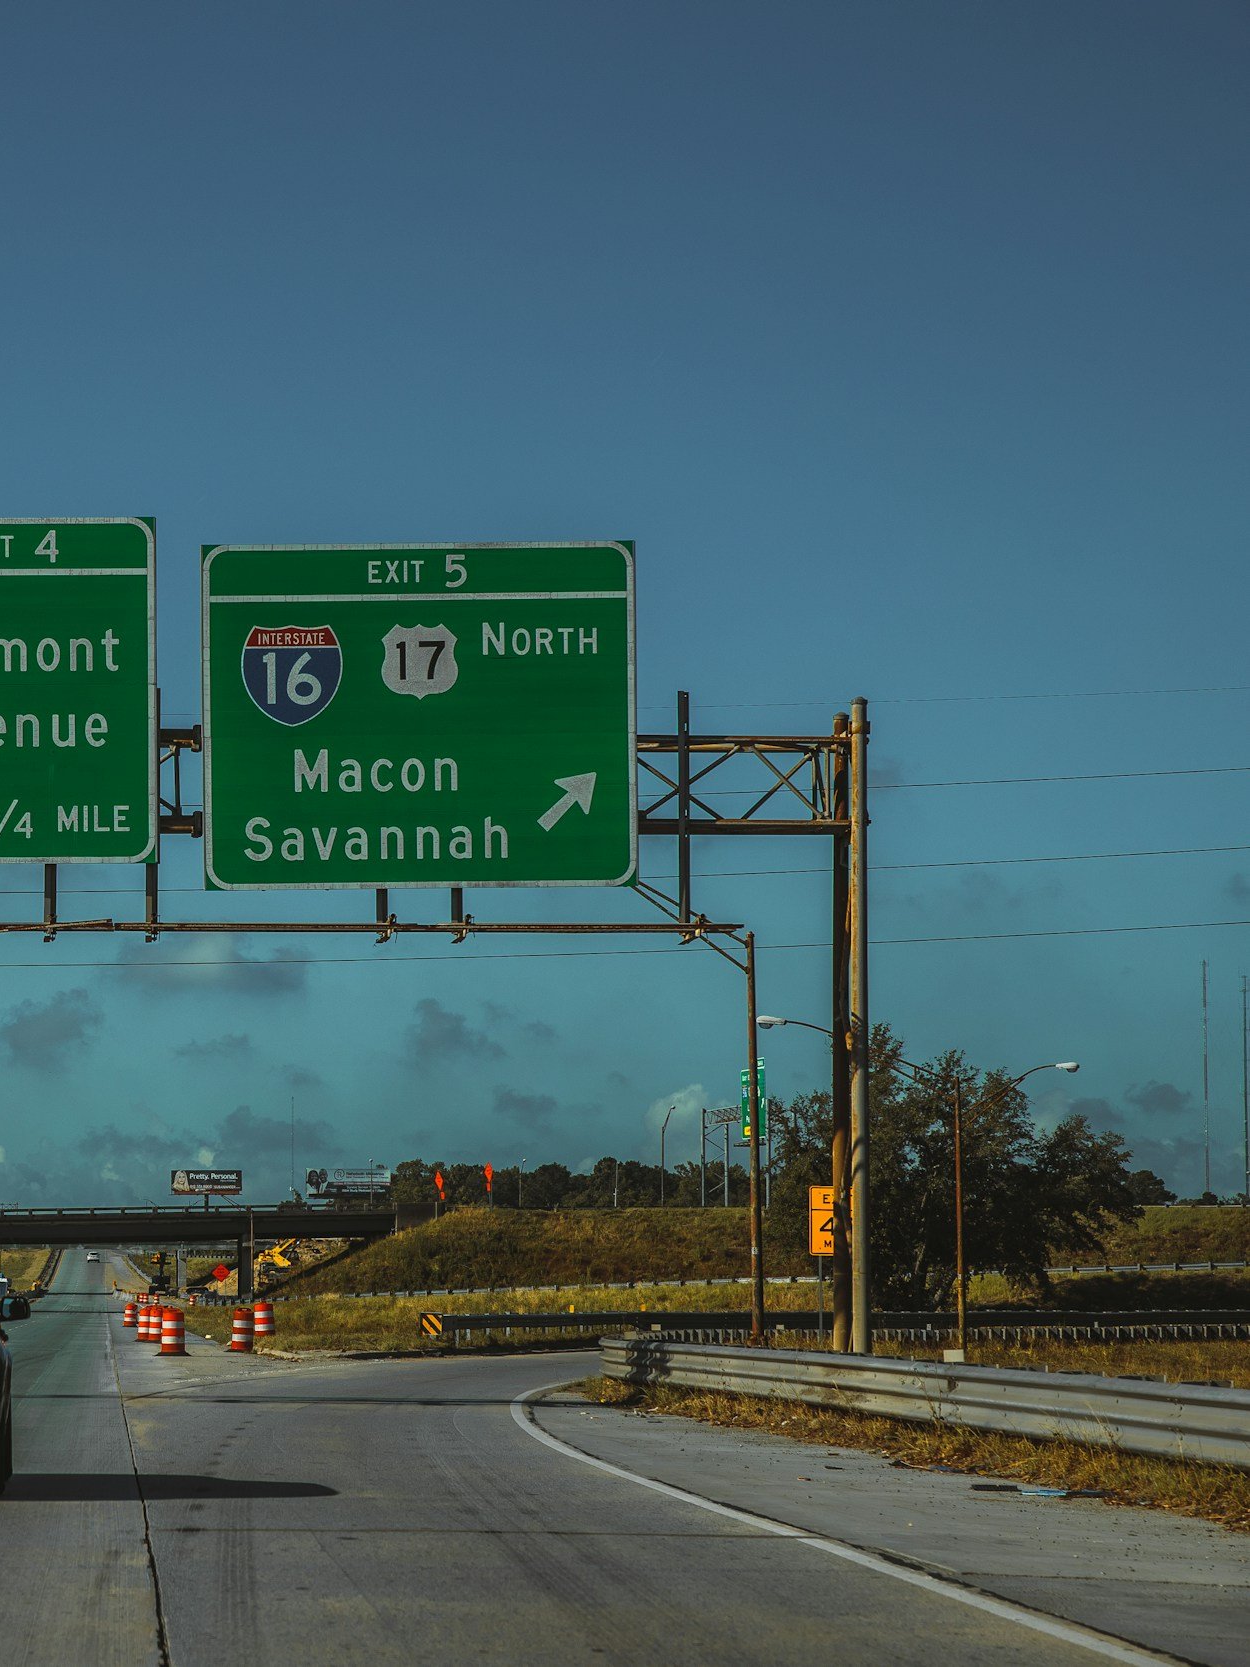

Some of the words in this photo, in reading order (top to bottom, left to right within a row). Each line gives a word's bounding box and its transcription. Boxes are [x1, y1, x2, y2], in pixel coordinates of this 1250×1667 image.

[35, 530, 59, 562] 4
[368, 561, 424, 583] EXIT
[446, 555, 467, 587] 5
[257, 632, 326, 646] INTERSTATE
[483, 623, 597, 655] NORTH
[396, 641, 445, 680] 17
[263, 652, 321, 705] 16
[295, 749, 457, 792] Macon
[58, 805, 130, 832] MILE
[244, 816, 508, 861] Savannah
[189, 1173, 209, 1181] Pretty.
